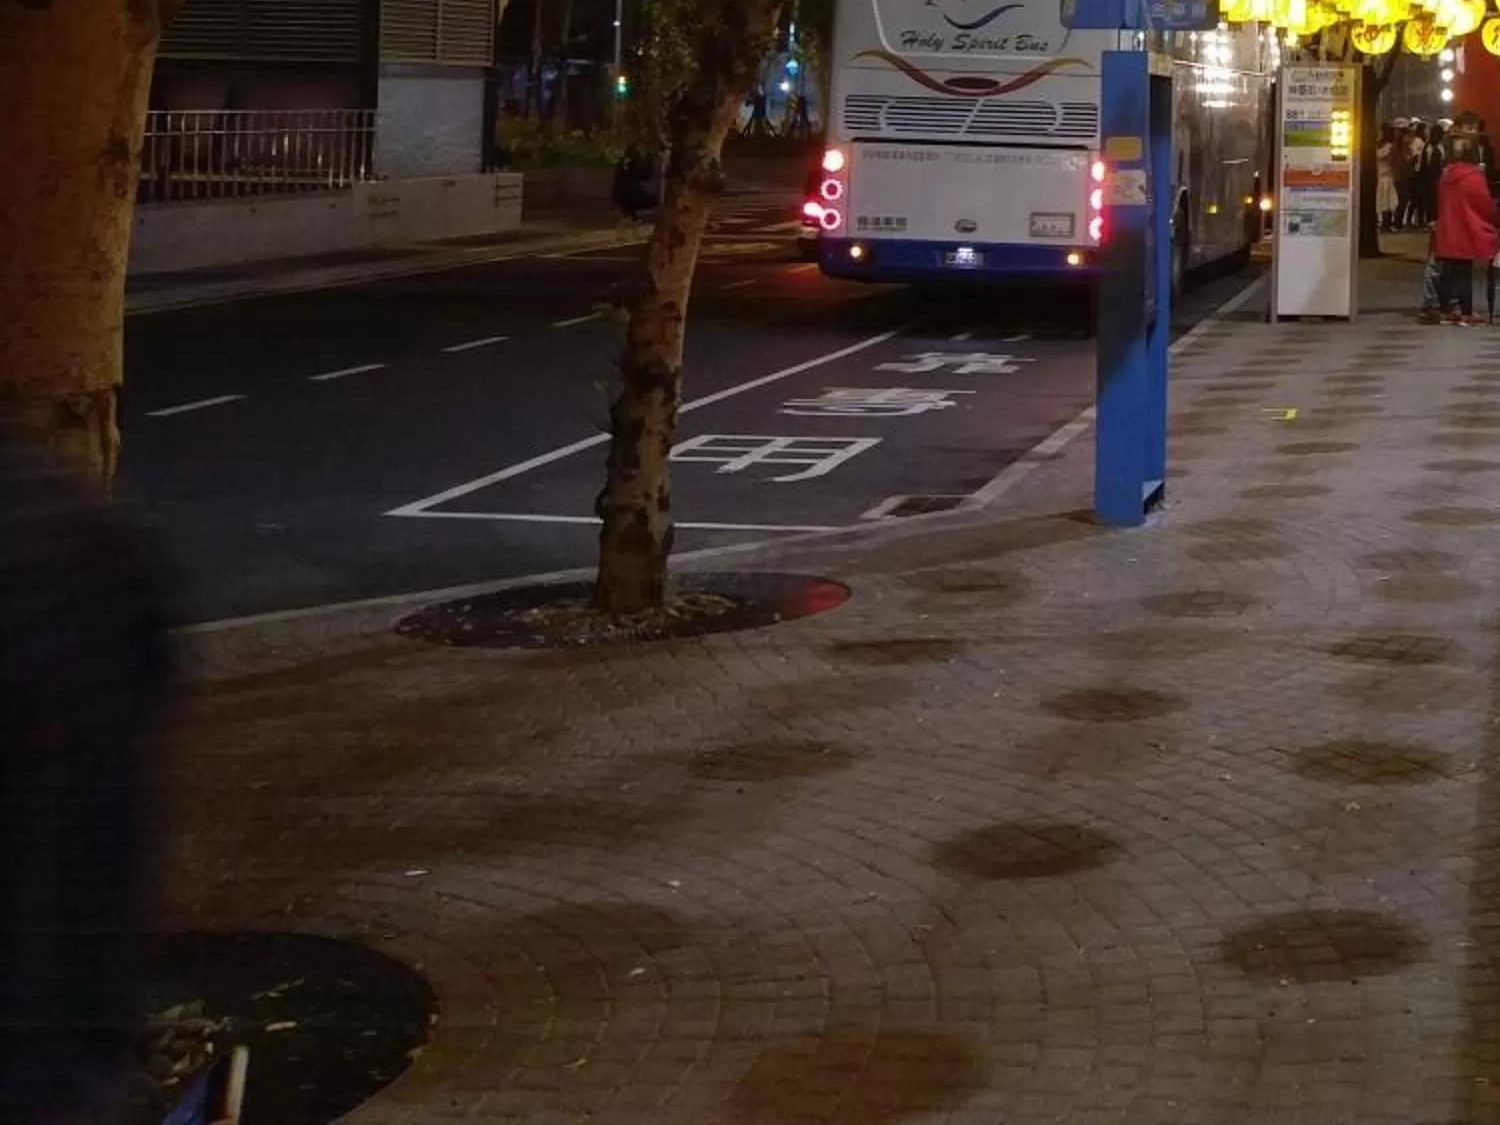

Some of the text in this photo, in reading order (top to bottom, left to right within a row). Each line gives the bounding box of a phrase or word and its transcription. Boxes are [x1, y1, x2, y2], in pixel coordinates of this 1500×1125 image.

[899, 30, 1049, 52] Holy Spirit Bus
